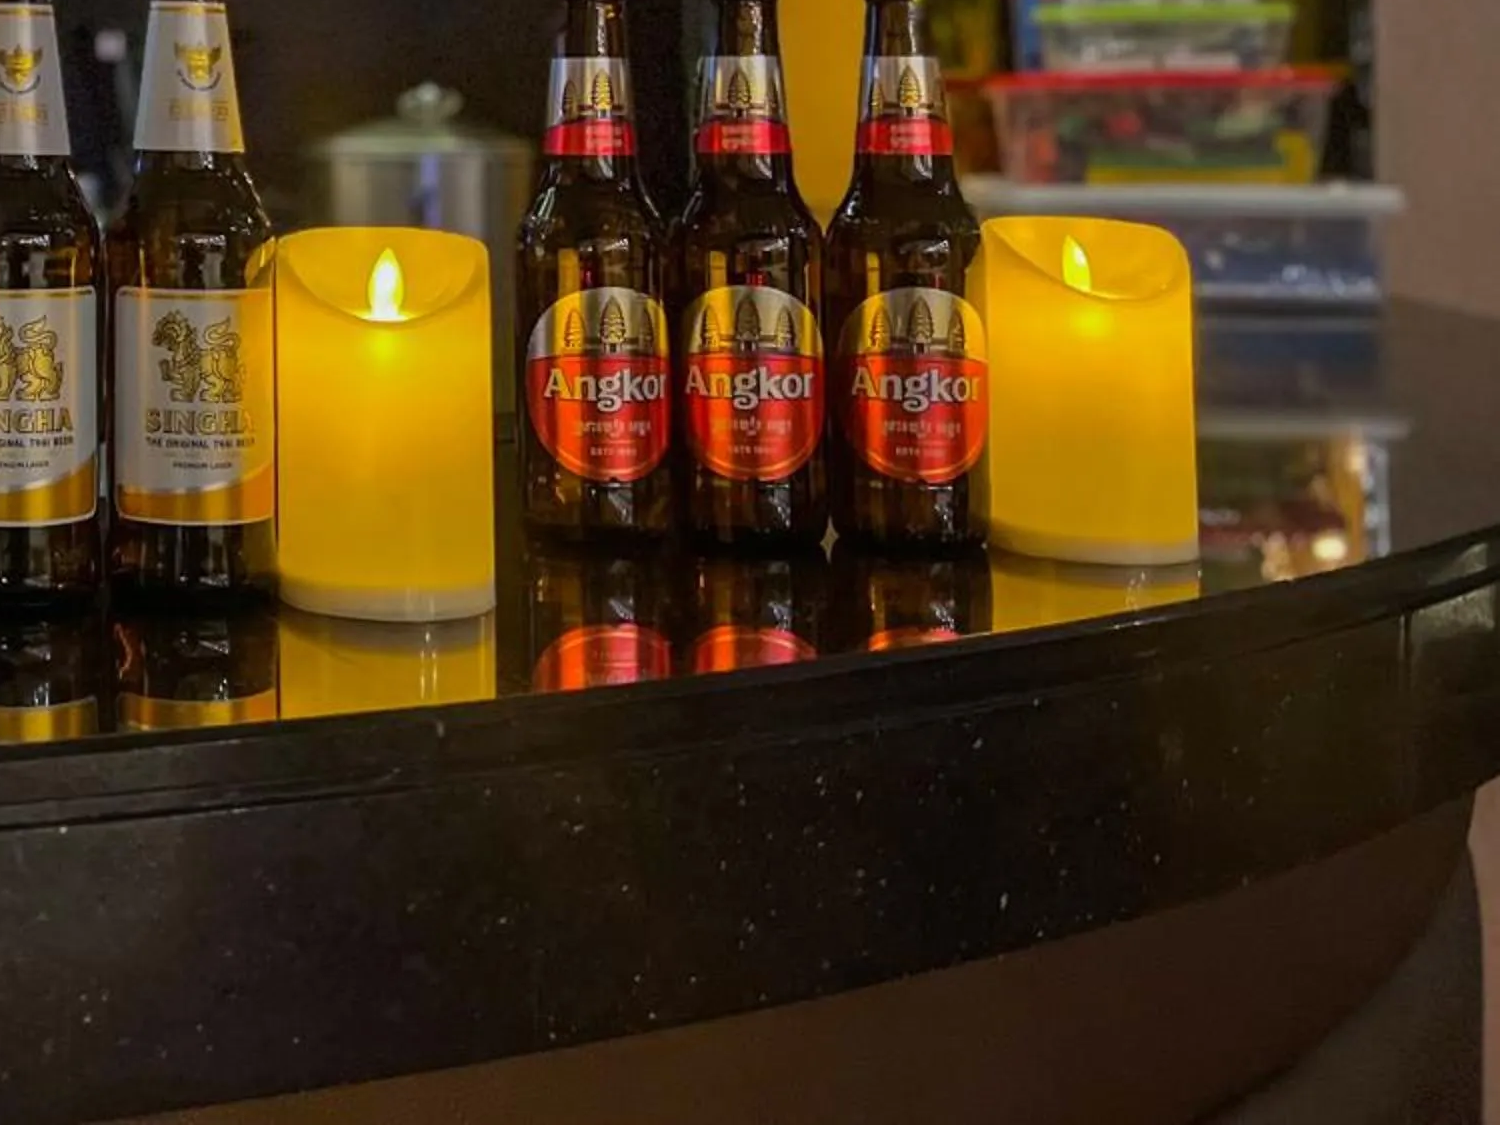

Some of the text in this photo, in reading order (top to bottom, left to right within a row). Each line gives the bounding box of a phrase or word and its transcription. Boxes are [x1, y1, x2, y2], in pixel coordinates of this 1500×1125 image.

[544, 368, 666, 411] Angkor
[685, 365, 815, 411] Angkor
[852, 366, 981, 412] Angkor
[146, 407, 255, 436] SINGHA
